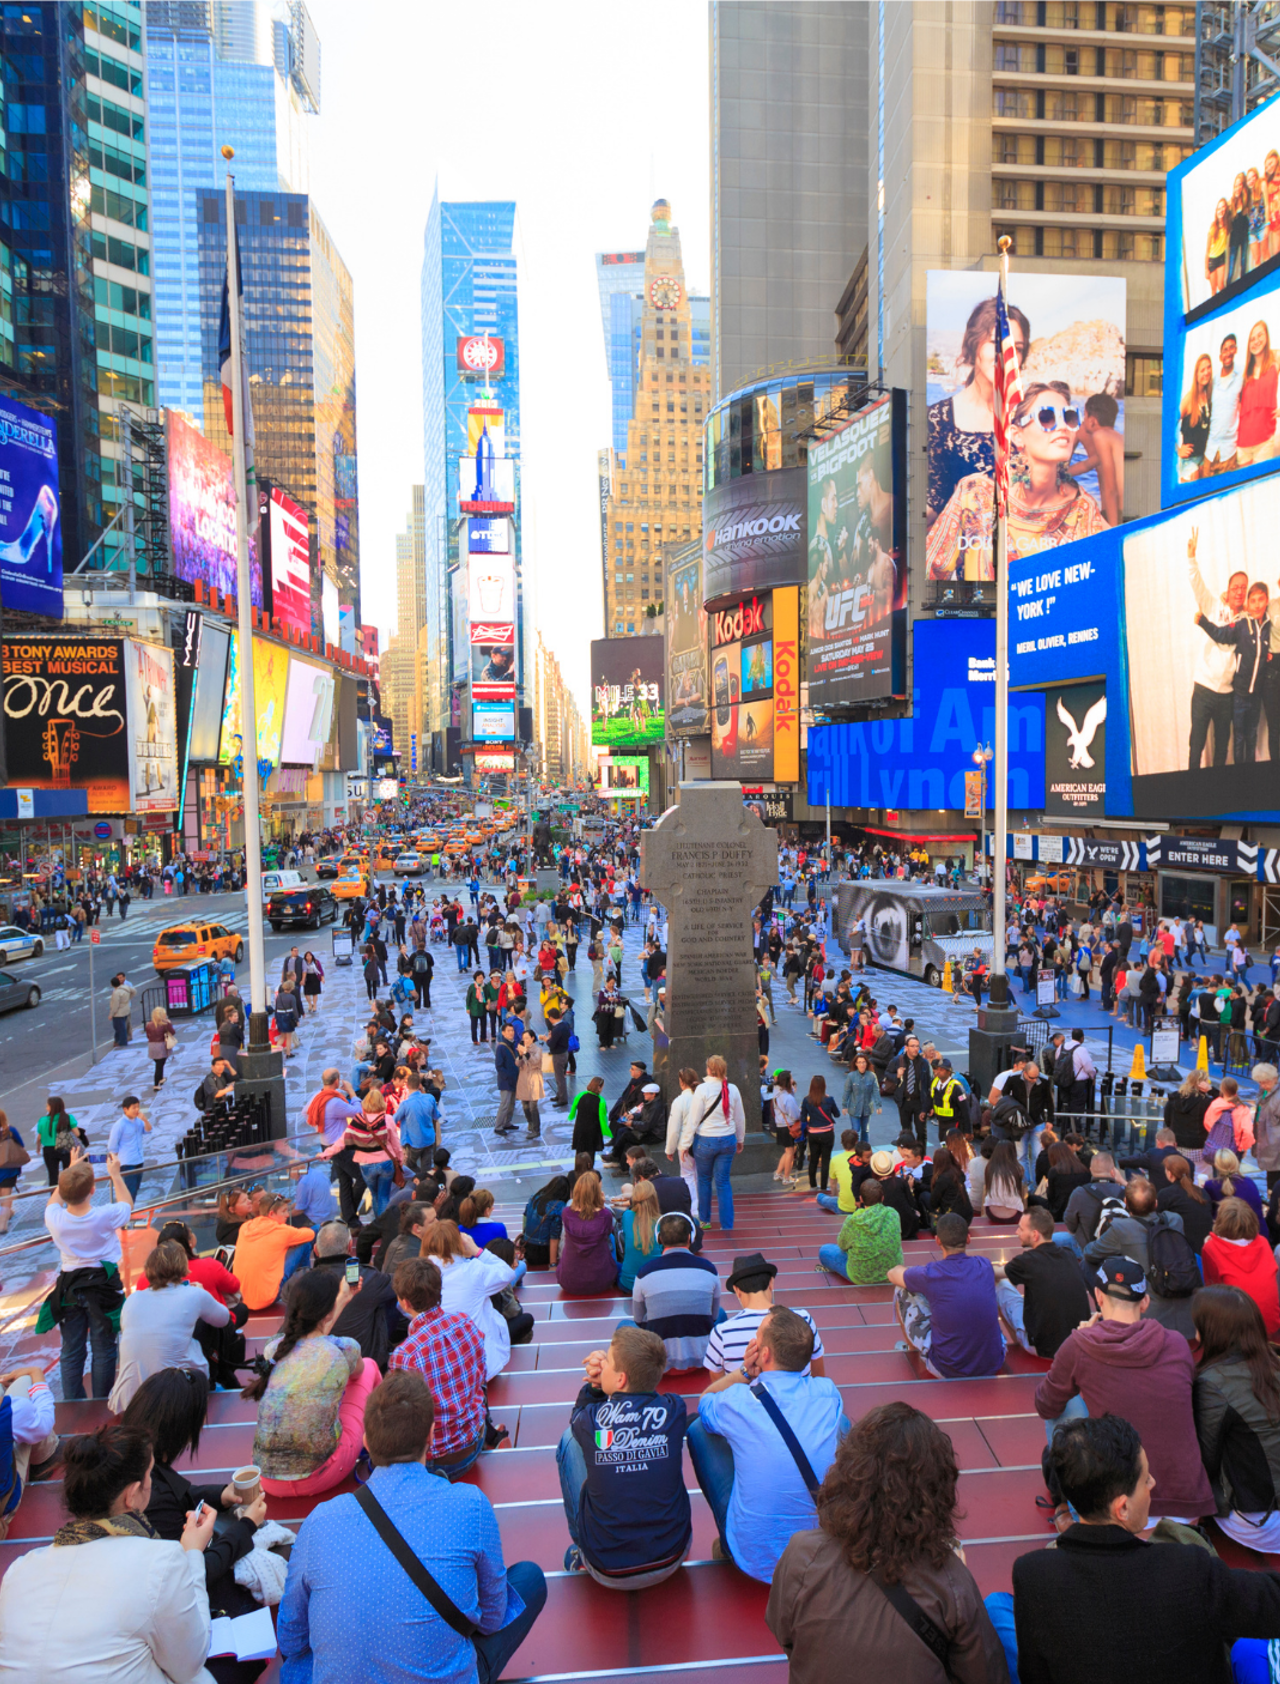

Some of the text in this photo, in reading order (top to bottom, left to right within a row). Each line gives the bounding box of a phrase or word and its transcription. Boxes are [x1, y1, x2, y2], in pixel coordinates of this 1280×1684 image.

[810, 402, 890, 467] VELASQUEZ
[818, 430, 877, 482] BIGFOOT
[879, 424, 890, 446] 2
[461, 501, 514, 511] TOSHIBA
[724, 532, 800, 552] driving emotion
[1036, 570, 1061, 592] LOVE
[1065, 561, 1095, 584] NEW-
[825, 584, 868, 631] UFC
[1017, 599, 1044, 621] YORK
[714, 596, 766, 645] Kodak
[875, 629, 889, 639] HUNT
[1068, 627, 1099, 645] RENNES
[11, 646, 52, 658] TONY
[54, 646, 118, 658] AWARDS
[821, 642, 875, 663] SATURDAY MAY 25
[3, 661, 119, 674] BEST MUSICAL
[814, 662, 827, 673] LIVE
[828, 660, 837, 670] ON
[595, 683, 658, 702] MILE 33
[775, 640, 796, 732] Kodak
[1050, 783, 1088, 793] AMERICAN
[671, 851, 710, 860] FRANCIS
[721, 850, 753, 859] DUFFY
[1100, 846, 1119, 855] WE'RE
[1100, 854, 1116, 862] OPEN
[1168, 851, 1229, 866] ENTER HERE
[642, 1406, 667, 1431] 79
[611, 1426, 669, 1450] Denim
[597, 1447, 666, 1462] PASSO DI GAVIA
[615, 1463, 648, 1473] ITALIA
